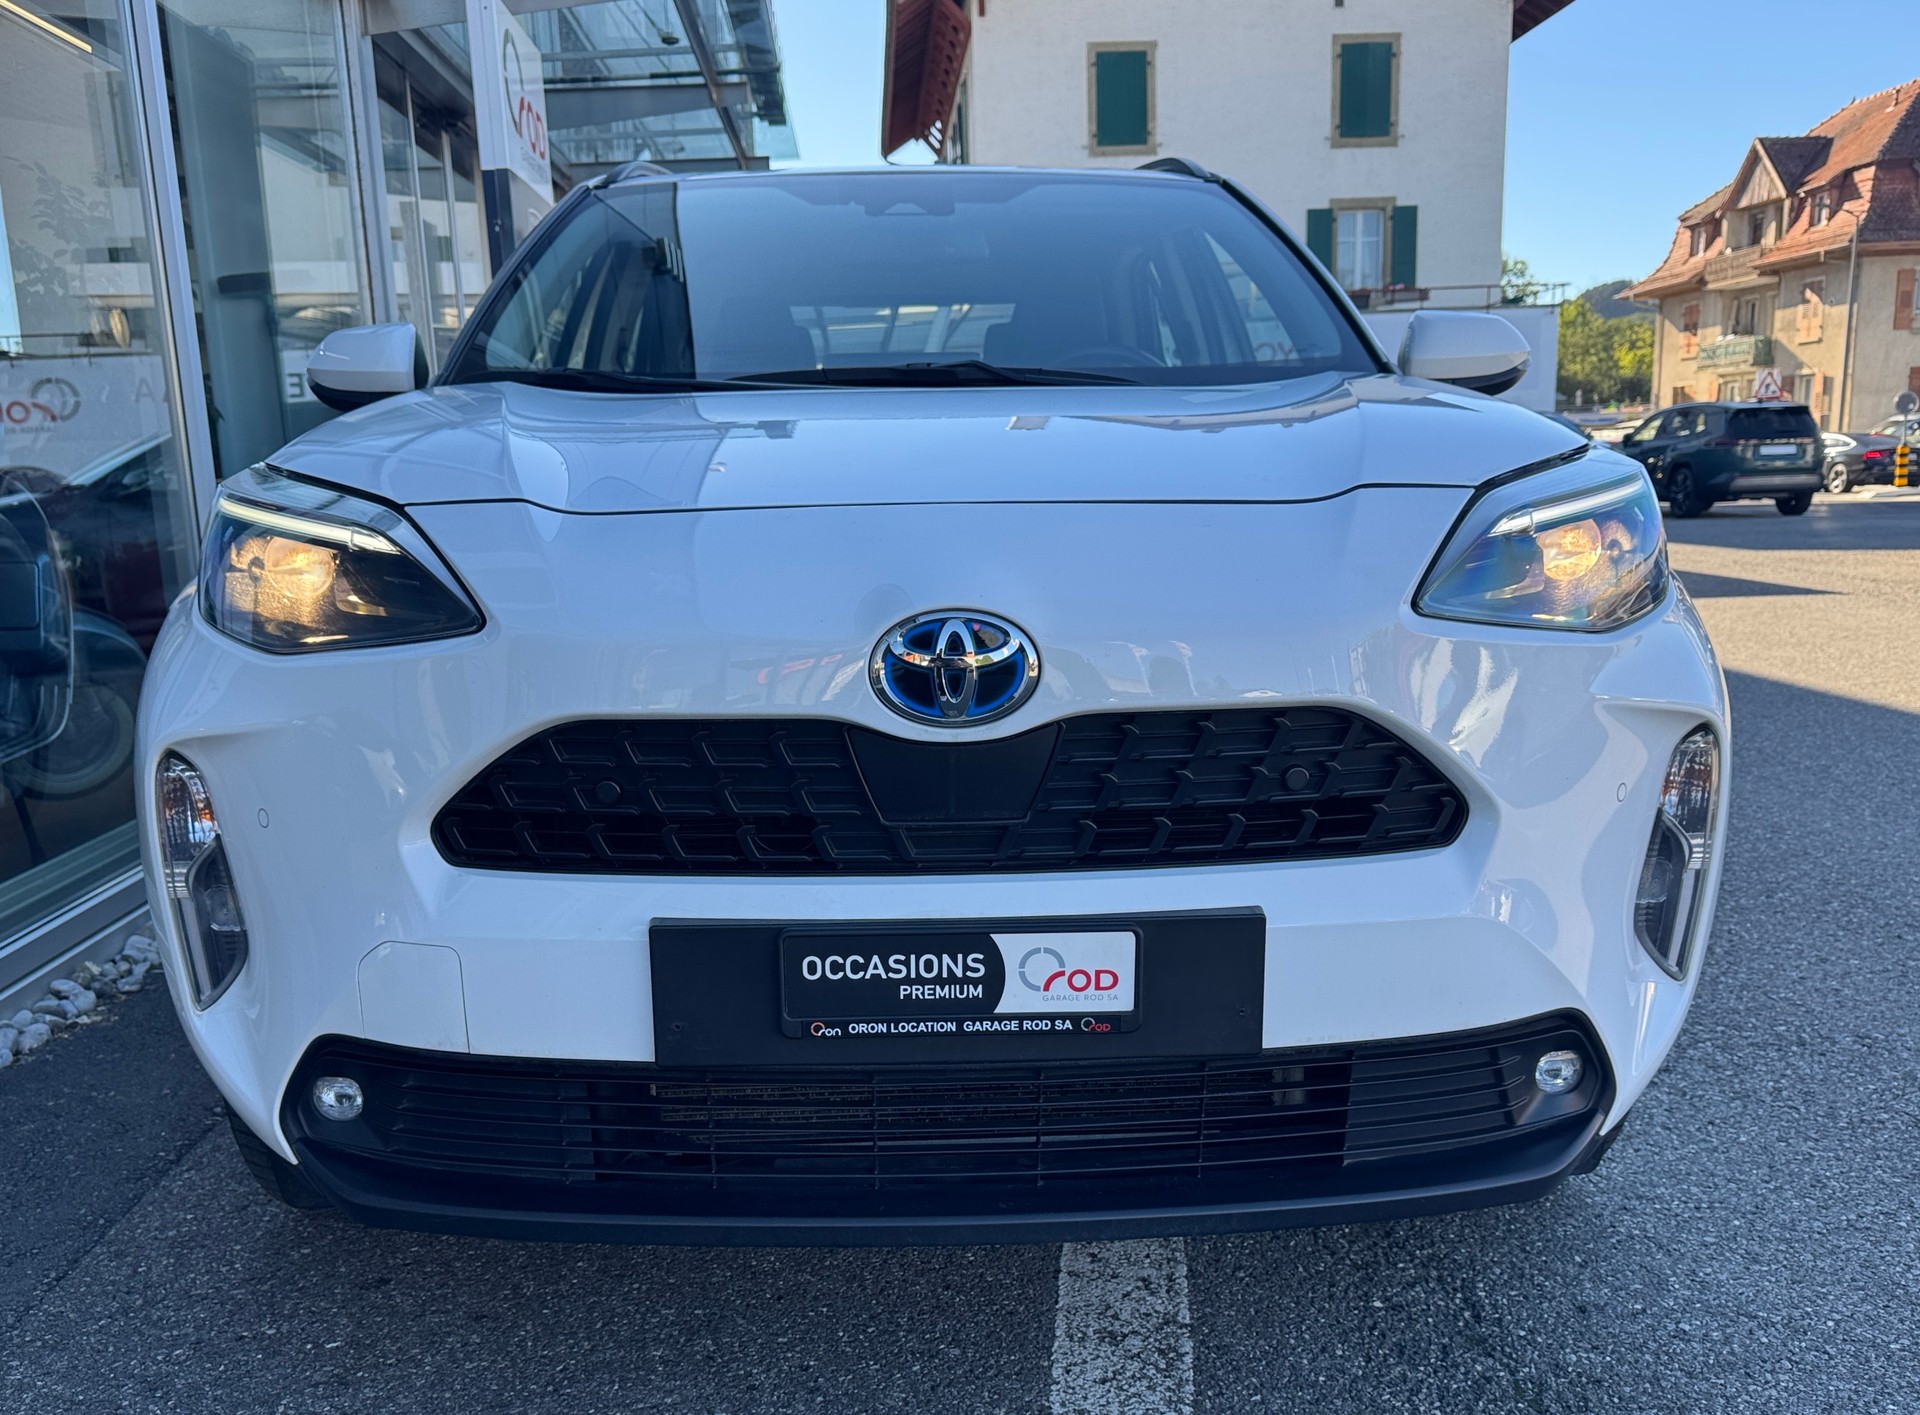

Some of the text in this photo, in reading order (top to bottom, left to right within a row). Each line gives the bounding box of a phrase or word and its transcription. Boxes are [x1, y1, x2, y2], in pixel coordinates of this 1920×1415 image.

[802, 953, 986, 980] OCCASIONS
[900, 984, 983, 1000] PREMIUM
[1042, 994, 1080, 1002] GARAGE
[1107, 993, 1119, 1001] SA
[848, 1022, 887, 1034] ORON
[890, 1021, 957, 1033] LOCATION
[963, 1020, 1019, 1032] GARAGE
[1023, 1019, 1051, 1031] ROD
[1054, 1019, 1073, 1031] SA
